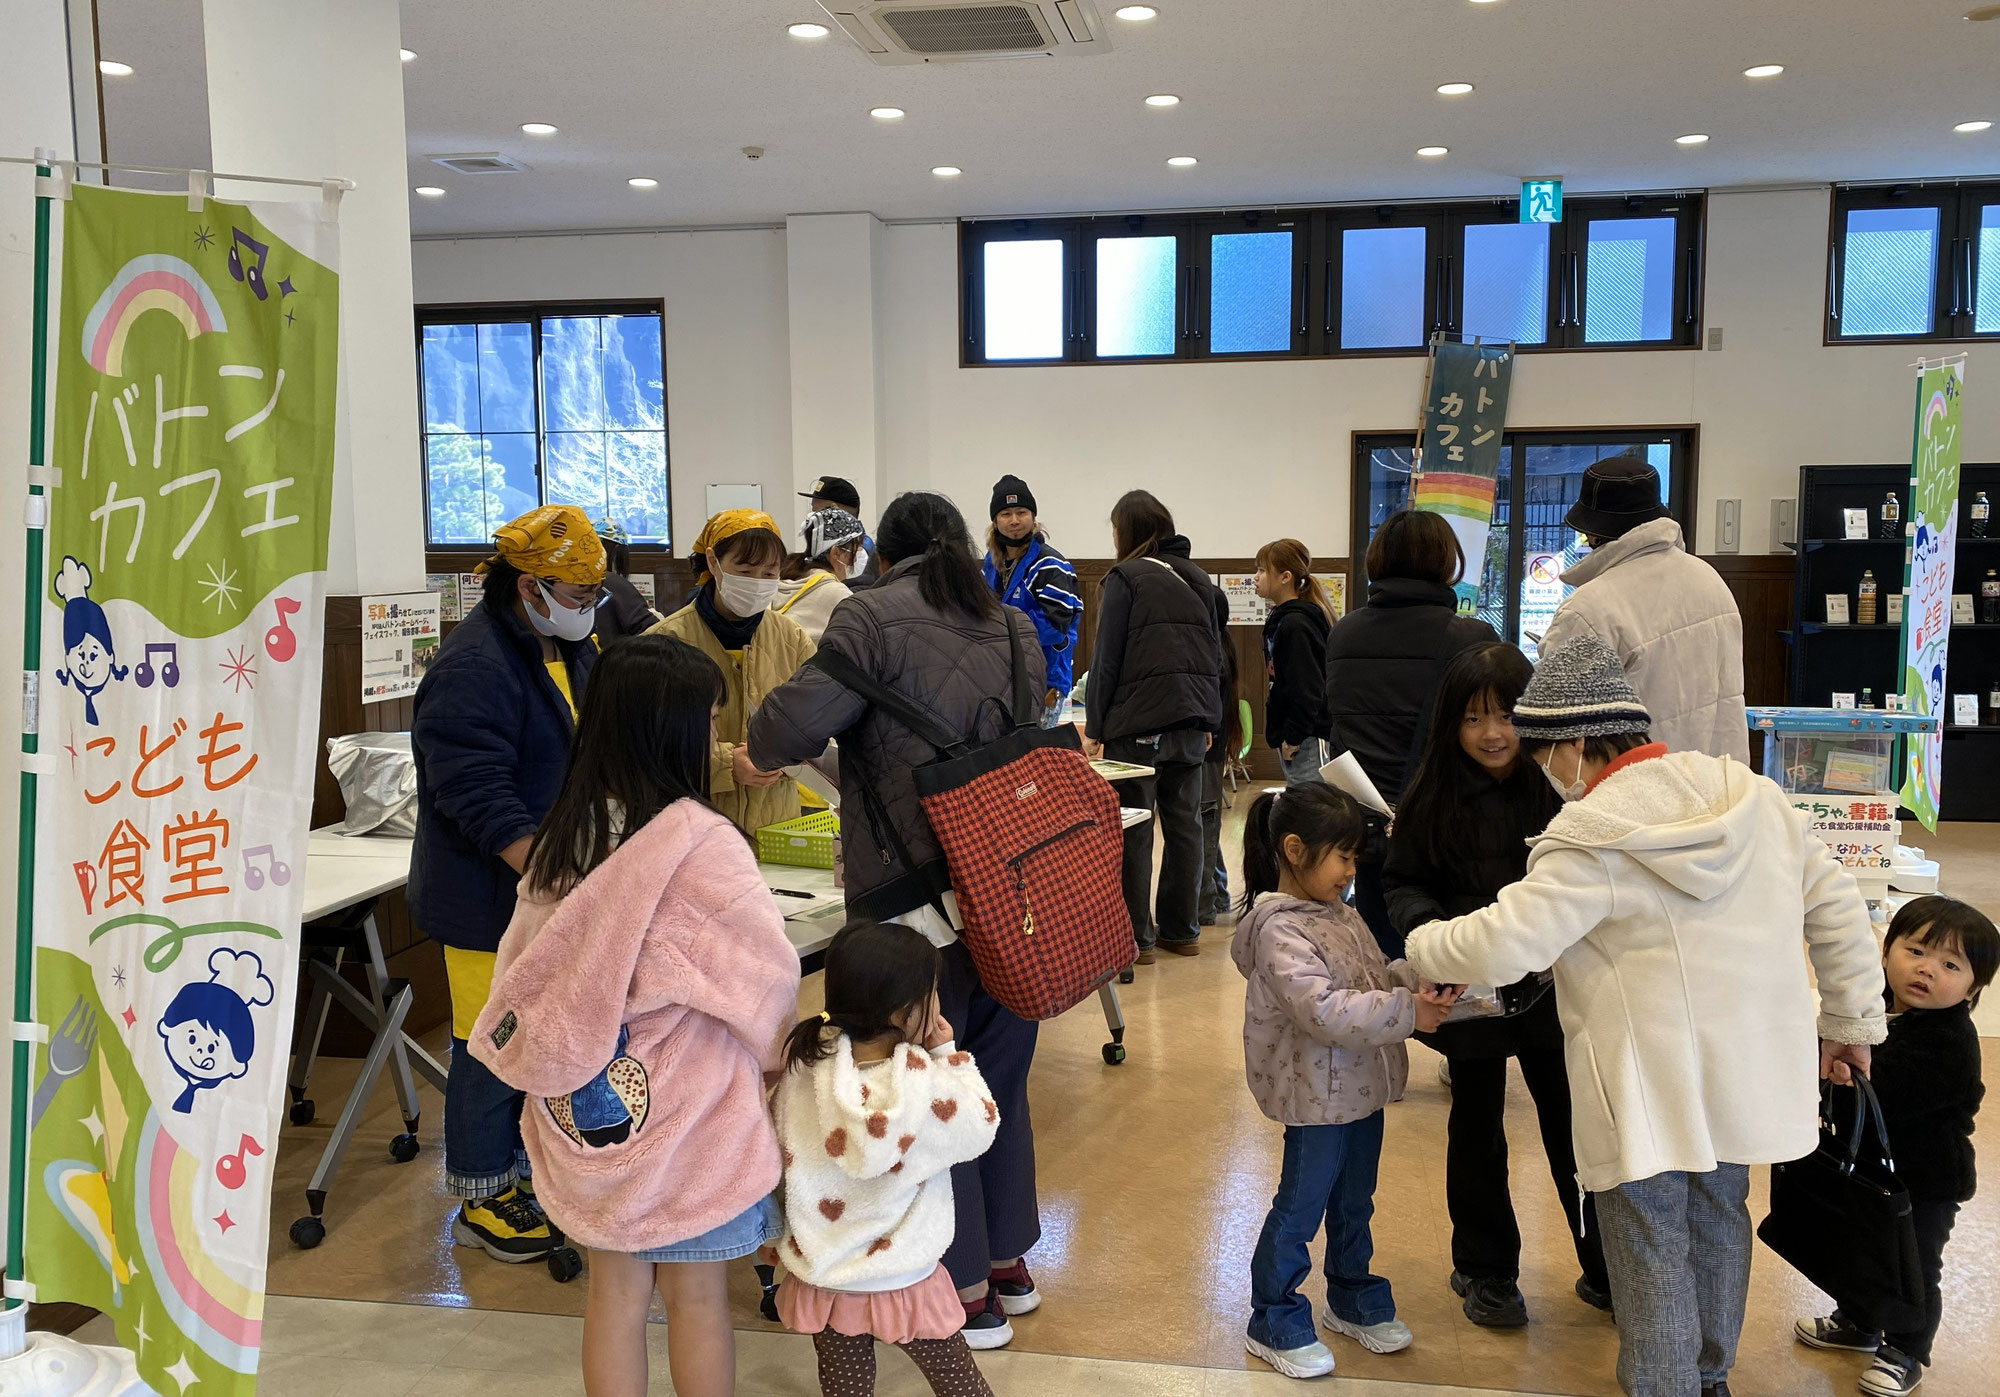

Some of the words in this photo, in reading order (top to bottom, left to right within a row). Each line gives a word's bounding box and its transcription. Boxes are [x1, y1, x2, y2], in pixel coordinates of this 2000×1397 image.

[81, 364, 285, 480] バトン
[1436, 391, 1464, 462] カフェ
[1471, 352, 1510, 447] バトン
[1922, 424, 1956, 481] バトン
[1924, 465, 1956, 515] カフェ
[90, 468, 300, 573] カフェ
[548, 538, 574, 564] POOH
[1920, 560, 1948, 604] こども
[1922, 597, 1944, 643] 食堂
[84, 711, 259, 805] こども
[1792, 802, 1893, 821] ちゃと書籍は
[98, 808, 230, 909] 食堂
[1836, 843, 1883, 855] なかよく
